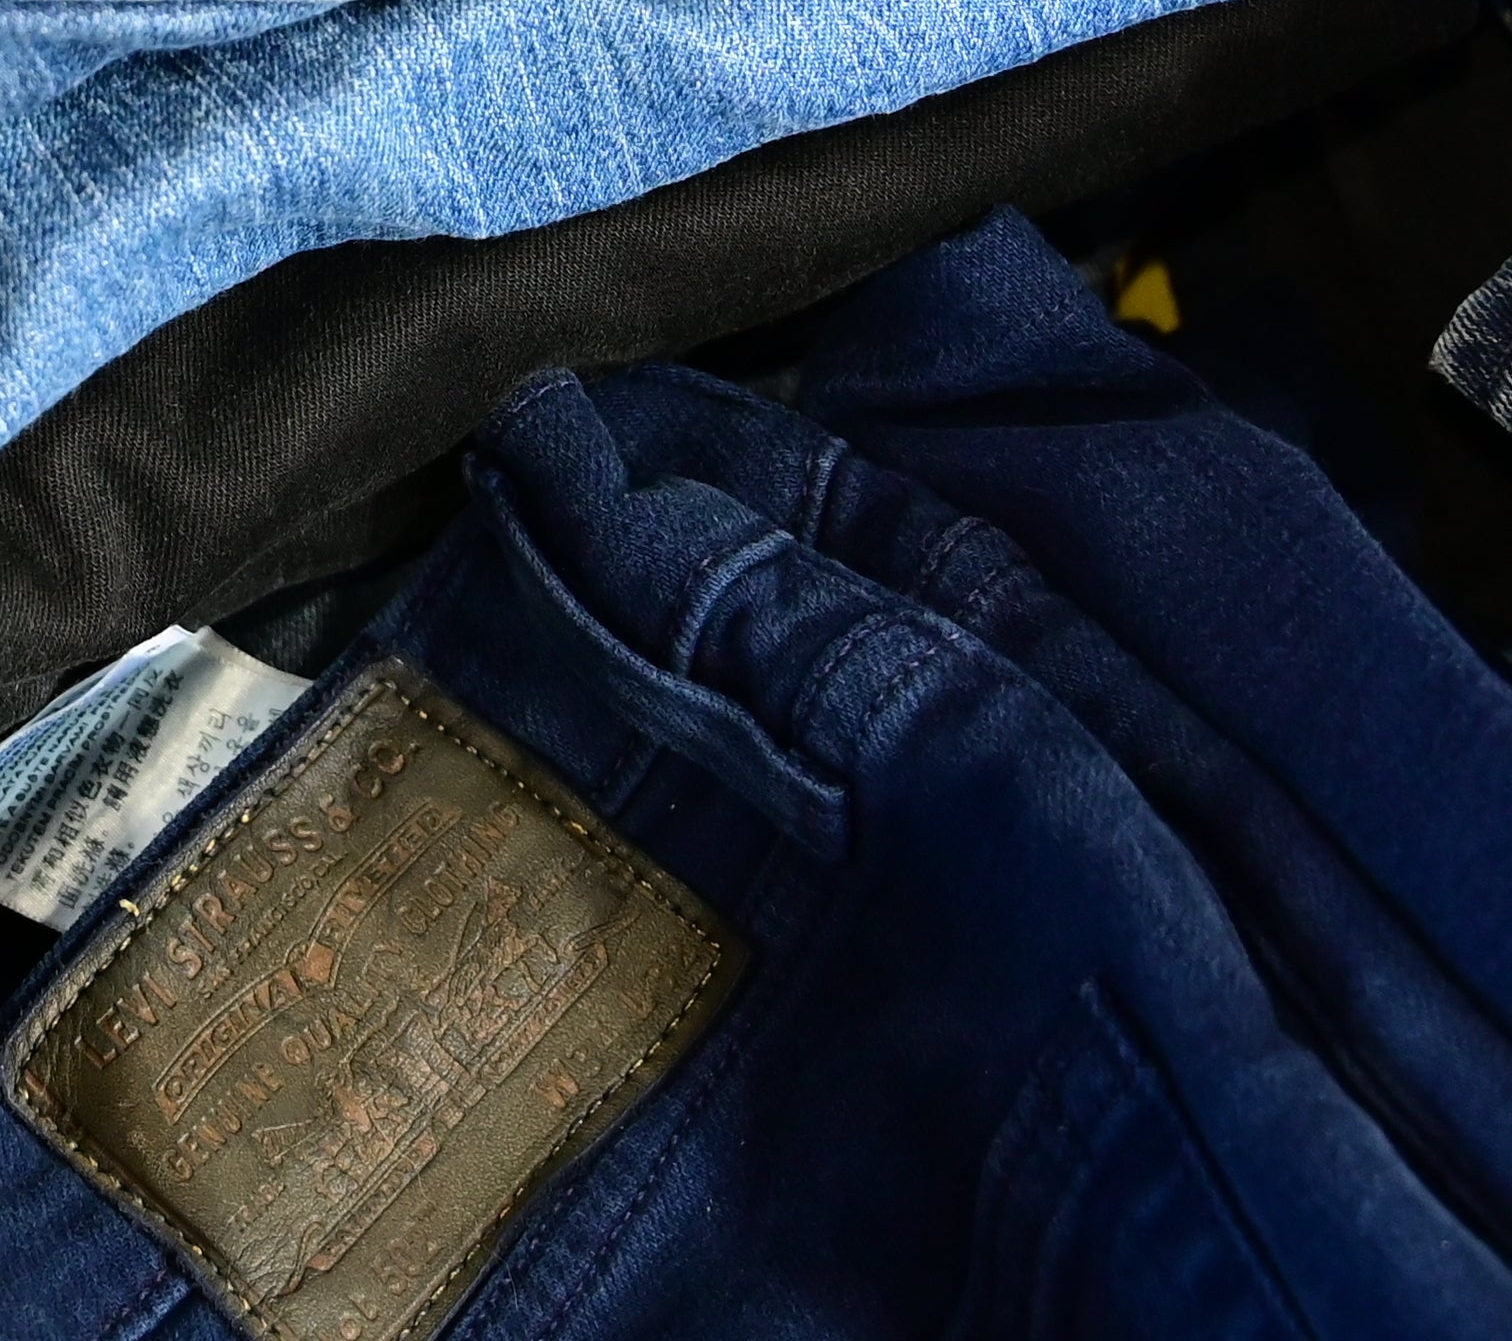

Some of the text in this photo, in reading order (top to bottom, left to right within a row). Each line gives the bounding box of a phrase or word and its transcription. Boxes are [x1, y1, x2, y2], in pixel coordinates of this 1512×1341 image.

[8, 806, 18, 816] A
[72, 970, 178, 1069] LEVI
[165, 816, 323, 980] STRAUSS
[160, 1059, 284, 1182] GENUINE
[397, 799, 521, 936] CLOTHING
